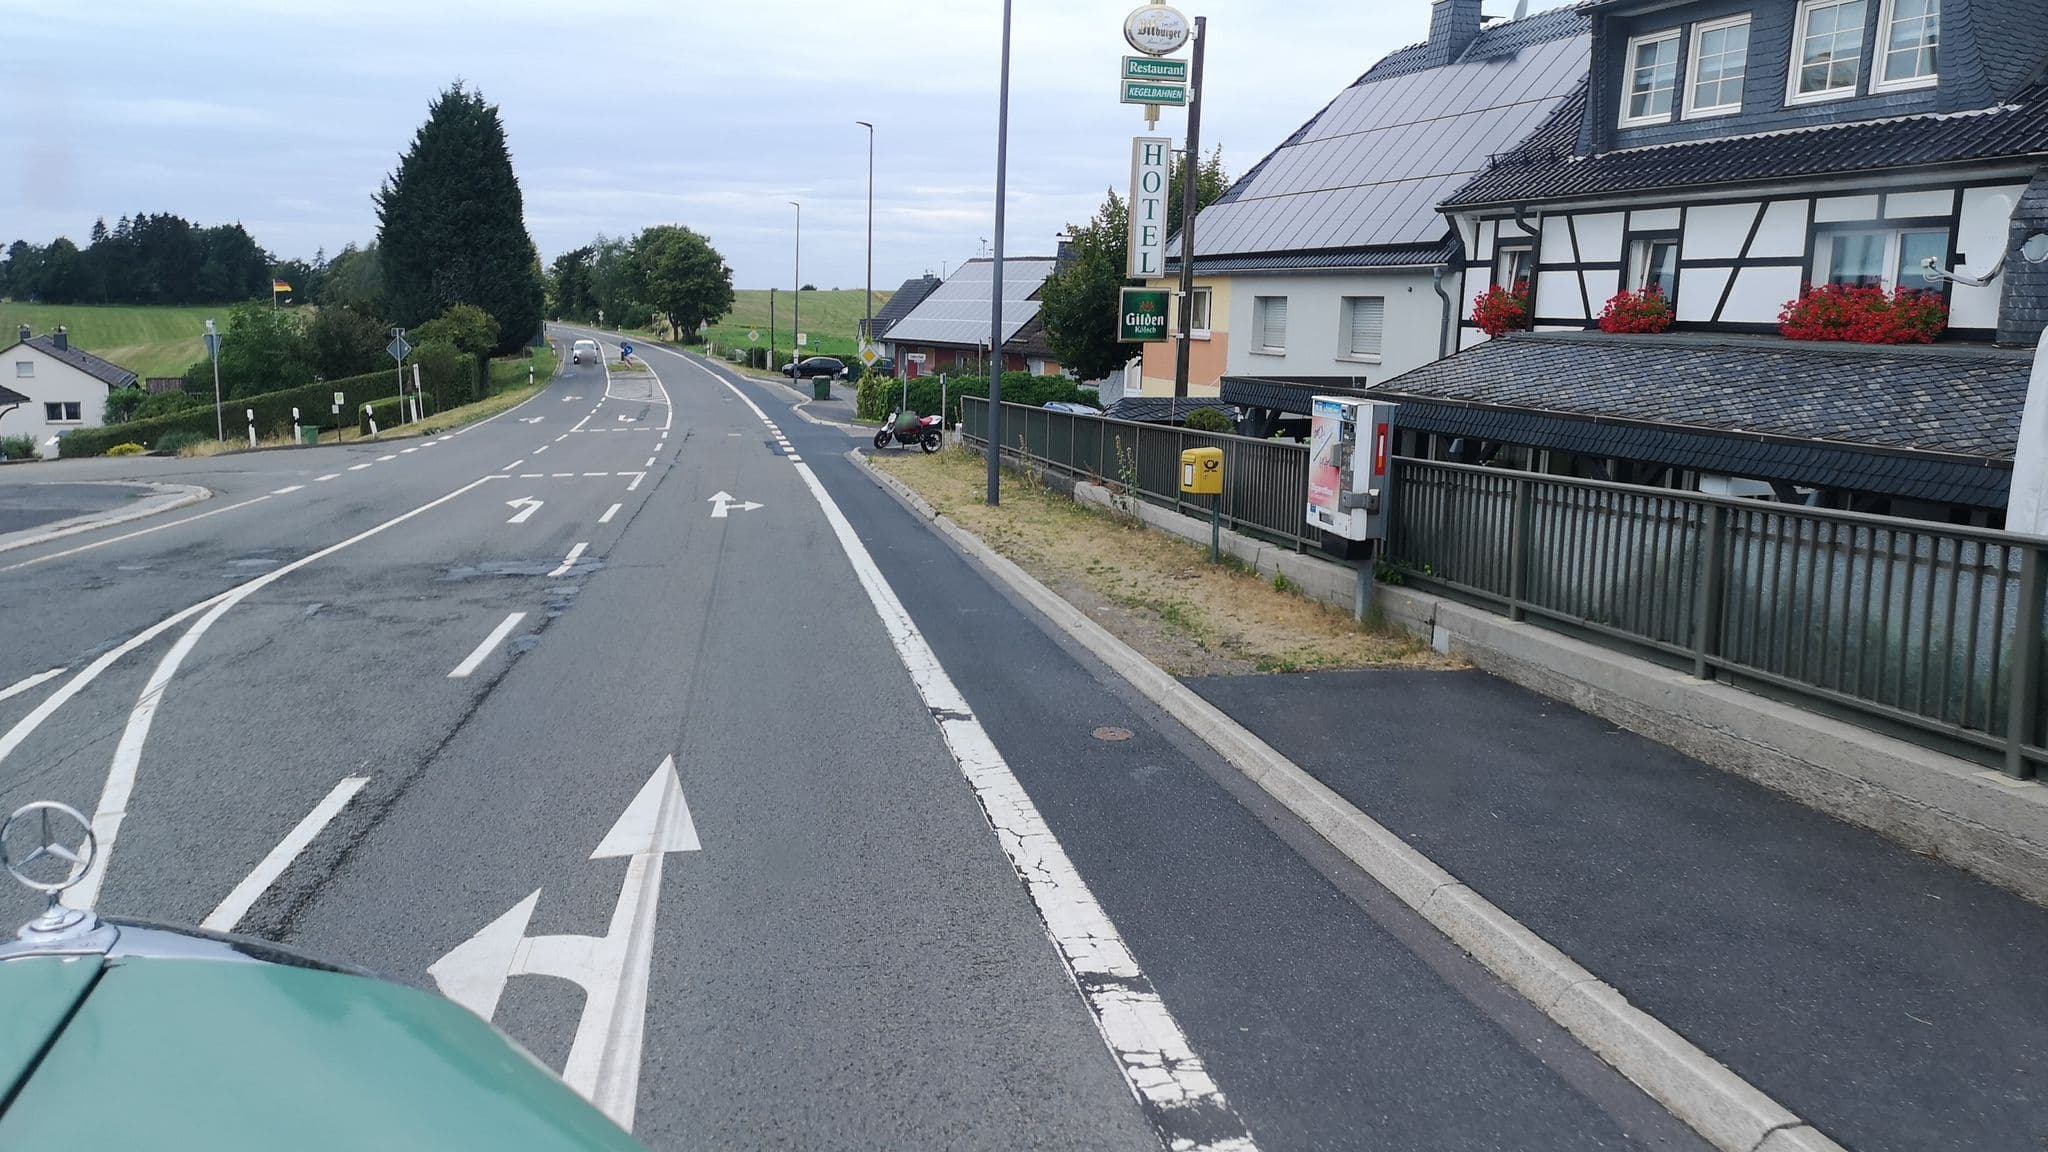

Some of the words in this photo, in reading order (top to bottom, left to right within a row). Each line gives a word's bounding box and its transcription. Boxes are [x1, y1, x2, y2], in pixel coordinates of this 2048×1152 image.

[1130, 61, 1184, 76] Restaurant
[1129, 87, 1183, 99] KEGELBAHNEN
[1141, 143, 1163, 274] HOTEL
[1126, 312, 1164, 326] Gilden
[1135, 325, 1157, 334] Kölsch
